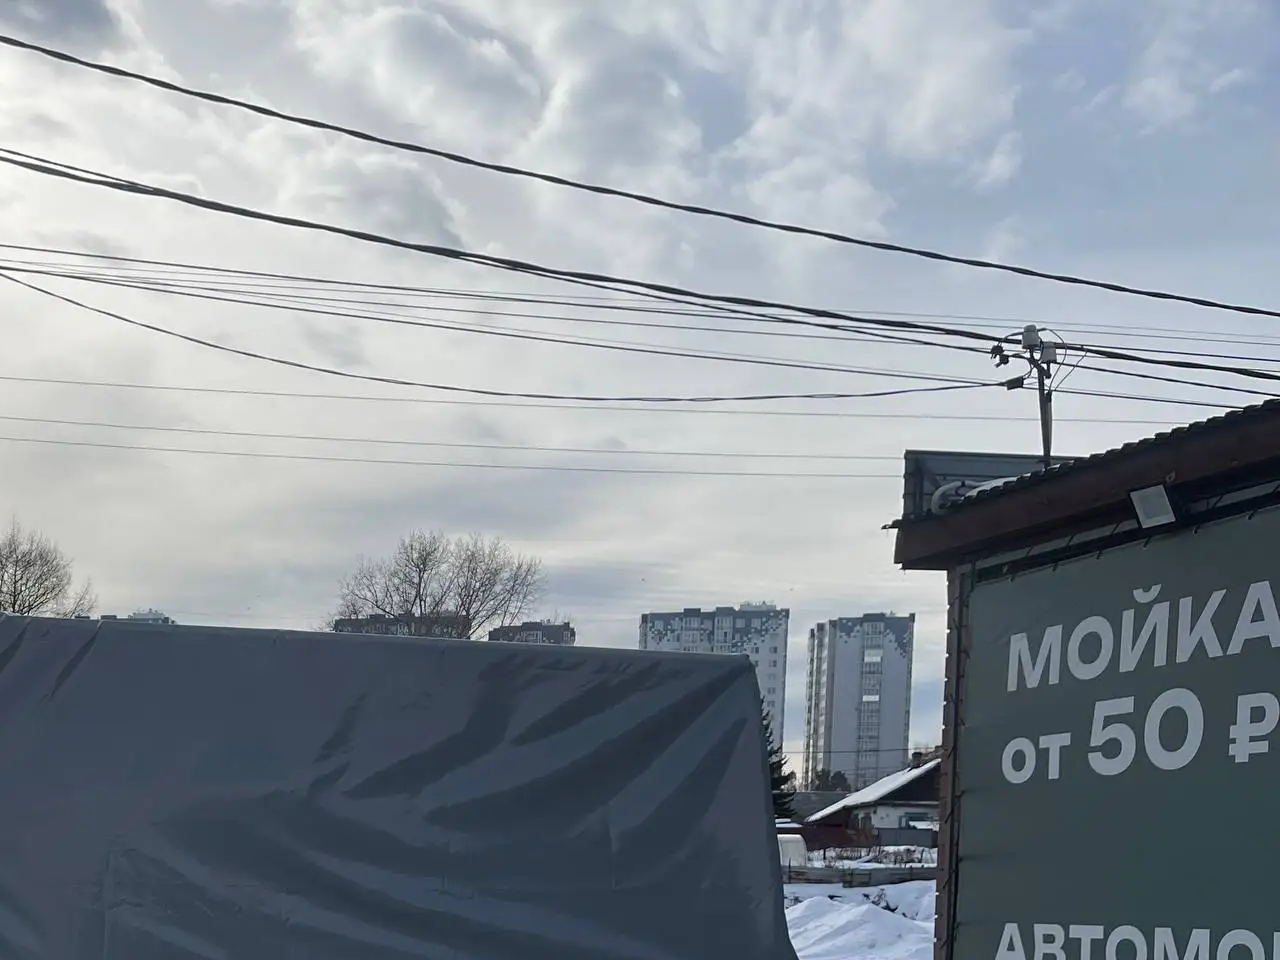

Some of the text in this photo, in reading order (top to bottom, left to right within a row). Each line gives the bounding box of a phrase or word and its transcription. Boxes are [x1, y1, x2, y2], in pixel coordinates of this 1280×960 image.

[1006, 579, 1280, 692] МОЙКА
[1087, 687, 1204, 776] 50
[1228, 692, 1280, 763] ₽
